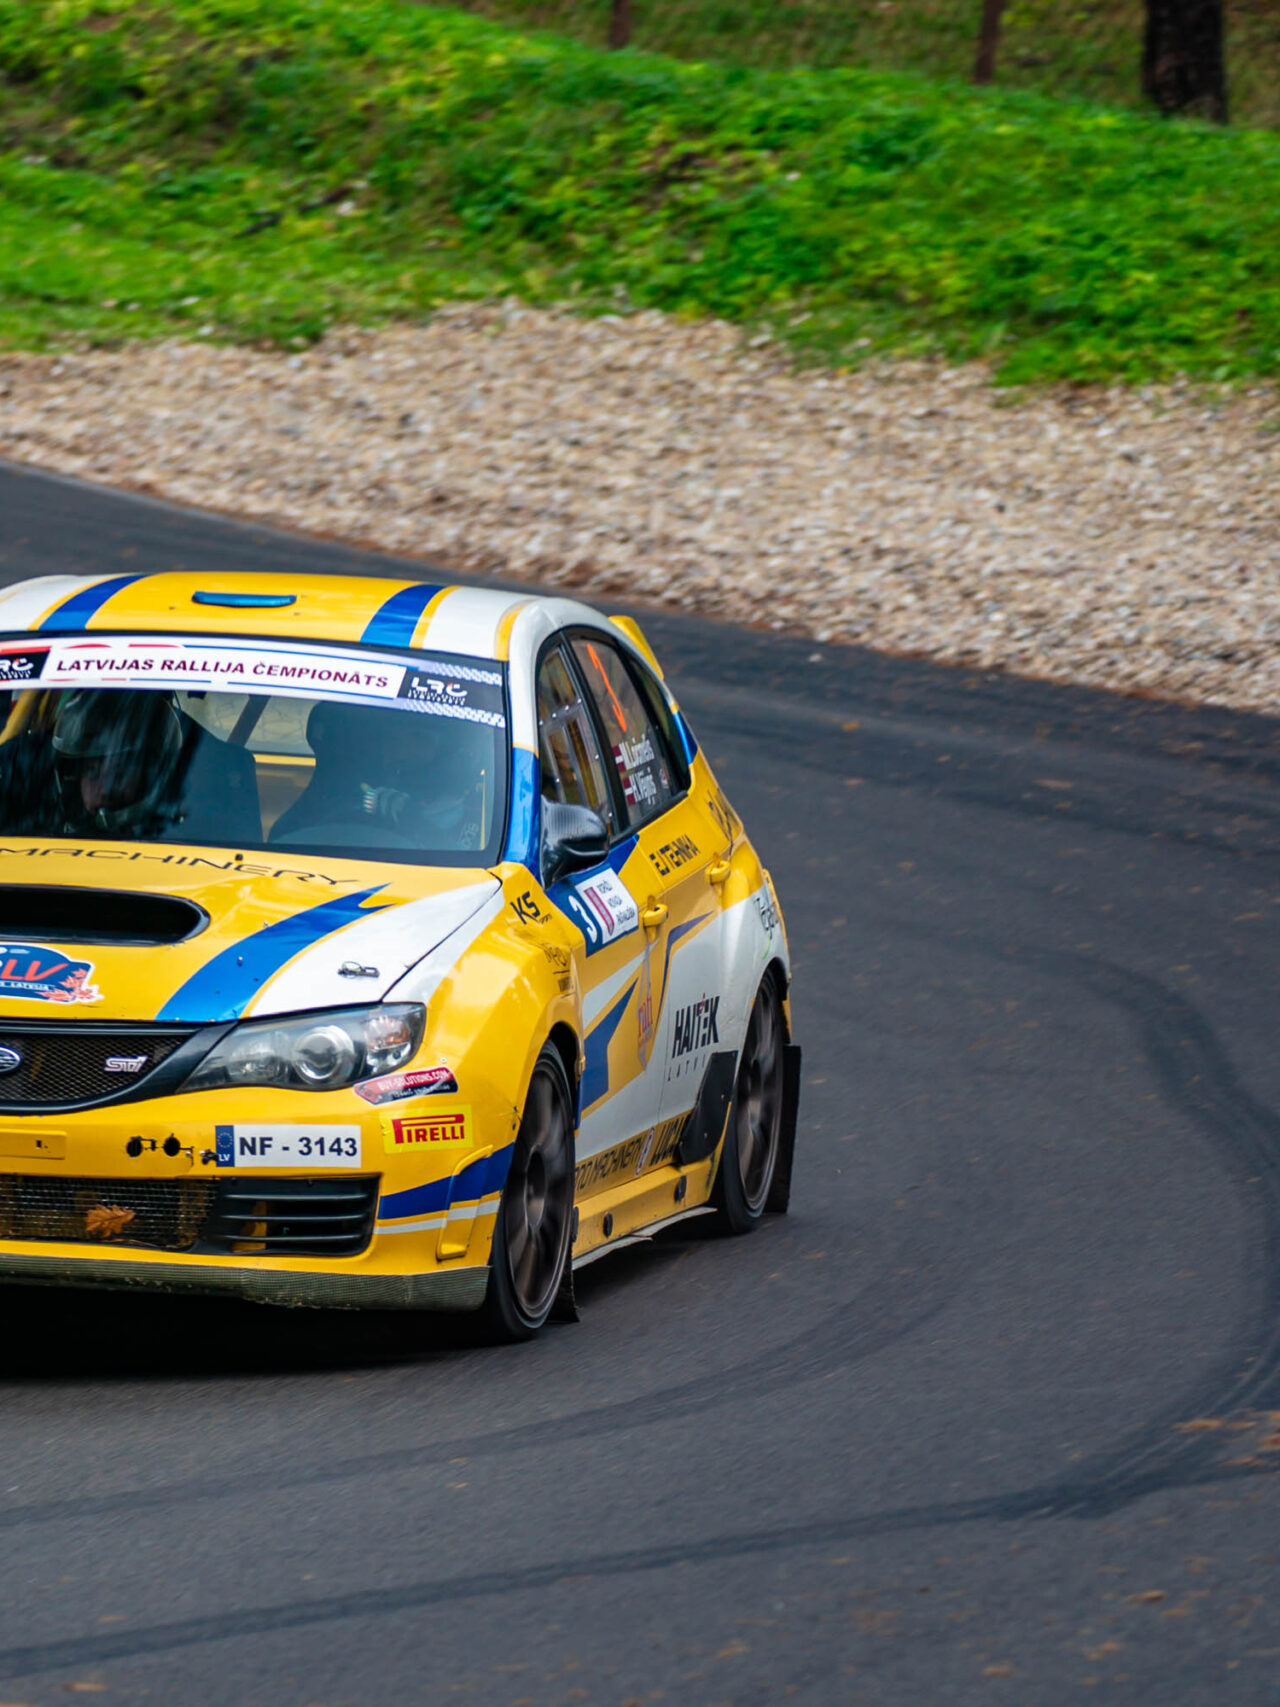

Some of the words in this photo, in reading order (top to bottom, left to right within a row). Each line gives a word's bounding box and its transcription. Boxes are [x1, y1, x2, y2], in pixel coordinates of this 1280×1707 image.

[57, 659, 154, 672] LATVIJAS
[160, 659, 245, 674] RALLIJA
[252, 662, 389, 688] ČEMPIONĀTS
[392, 1113, 465, 1145] PIRELLI
[239, 1136, 274, 1156] NF
[298, 1136, 358, 1157] 3143
